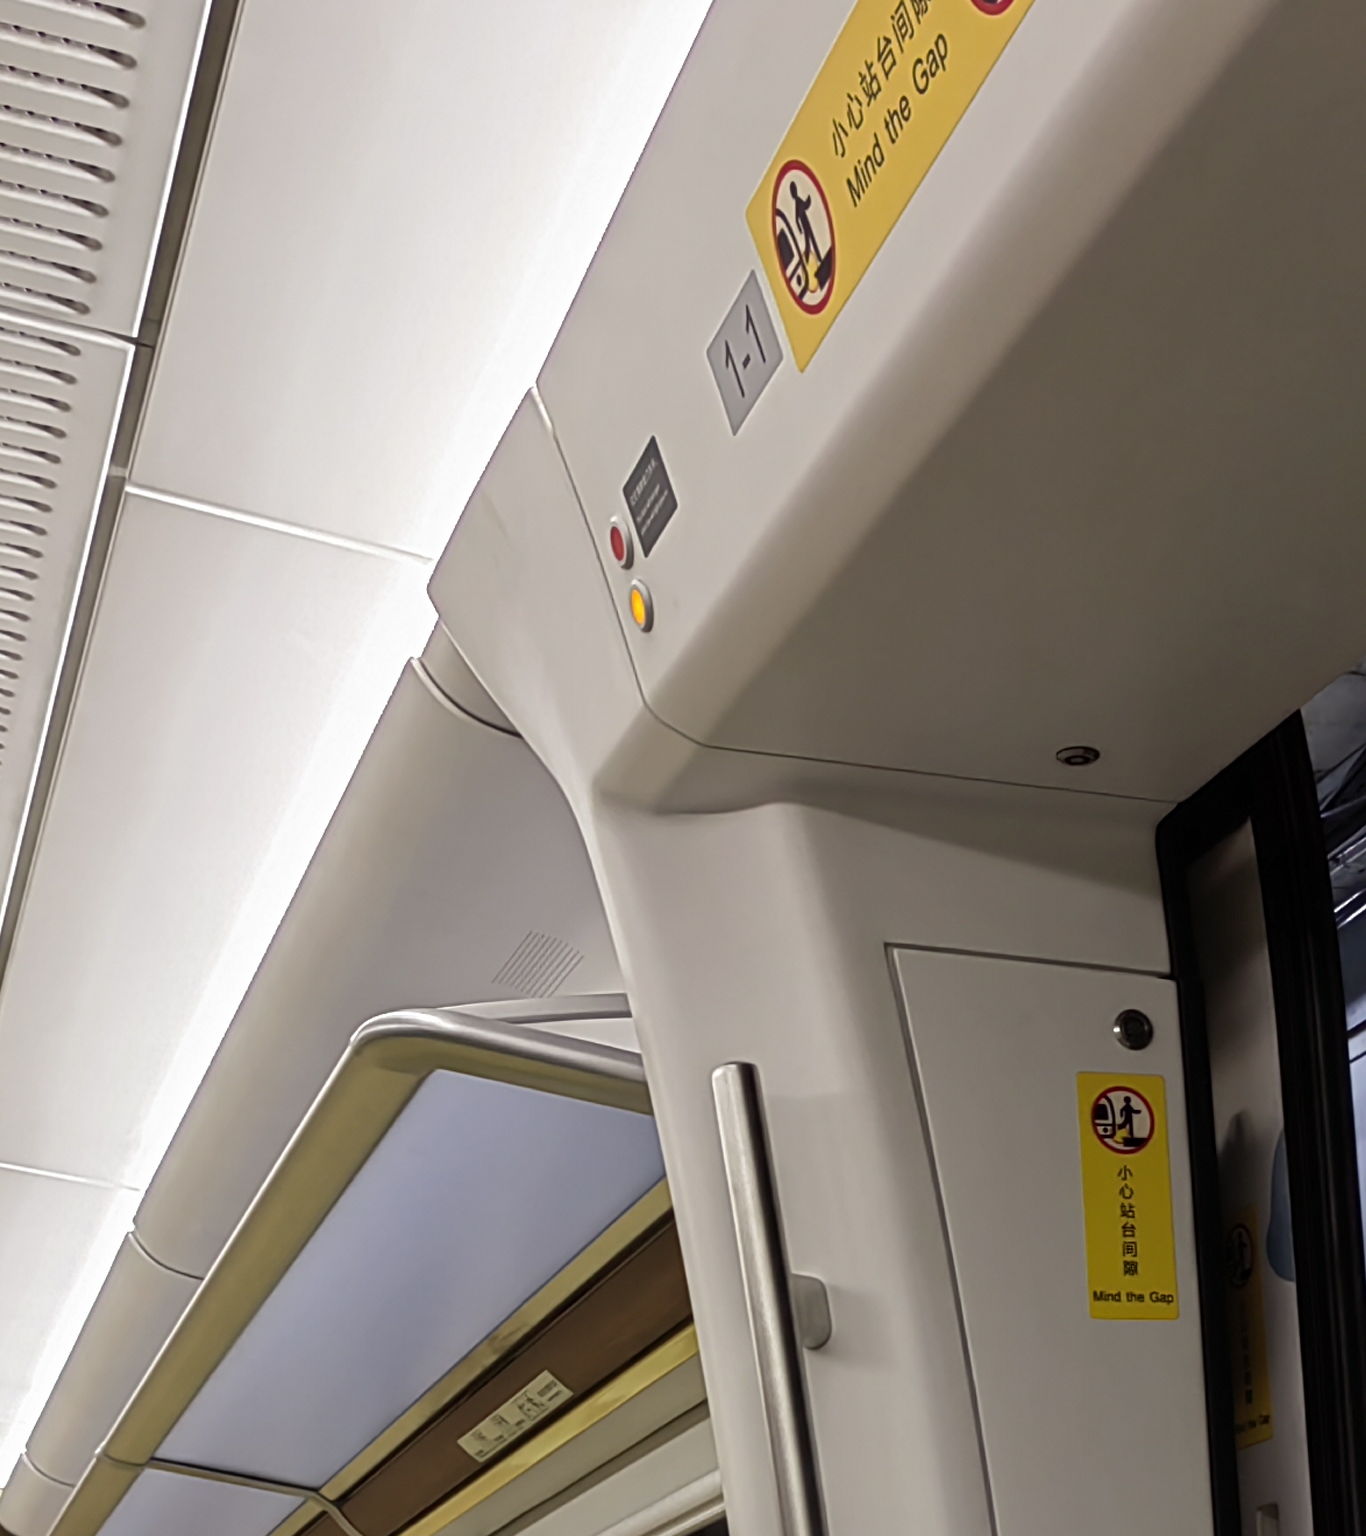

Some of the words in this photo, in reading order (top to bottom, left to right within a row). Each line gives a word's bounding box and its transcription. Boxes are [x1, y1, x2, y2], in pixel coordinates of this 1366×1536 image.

[846, 132, 885, 207] Mind
[884, 95, 912, 144] the
[912, 33, 949, 95] Gap
[724, 304, 766, 398] 1-1
[1117, 1165, 1138, 1277] 小心站台间隙
[1093, 1290, 1121, 1303] Mind
[1126, 1290, 1145, 1303] the
[1150, 1291, 1174, 1305] Gap
